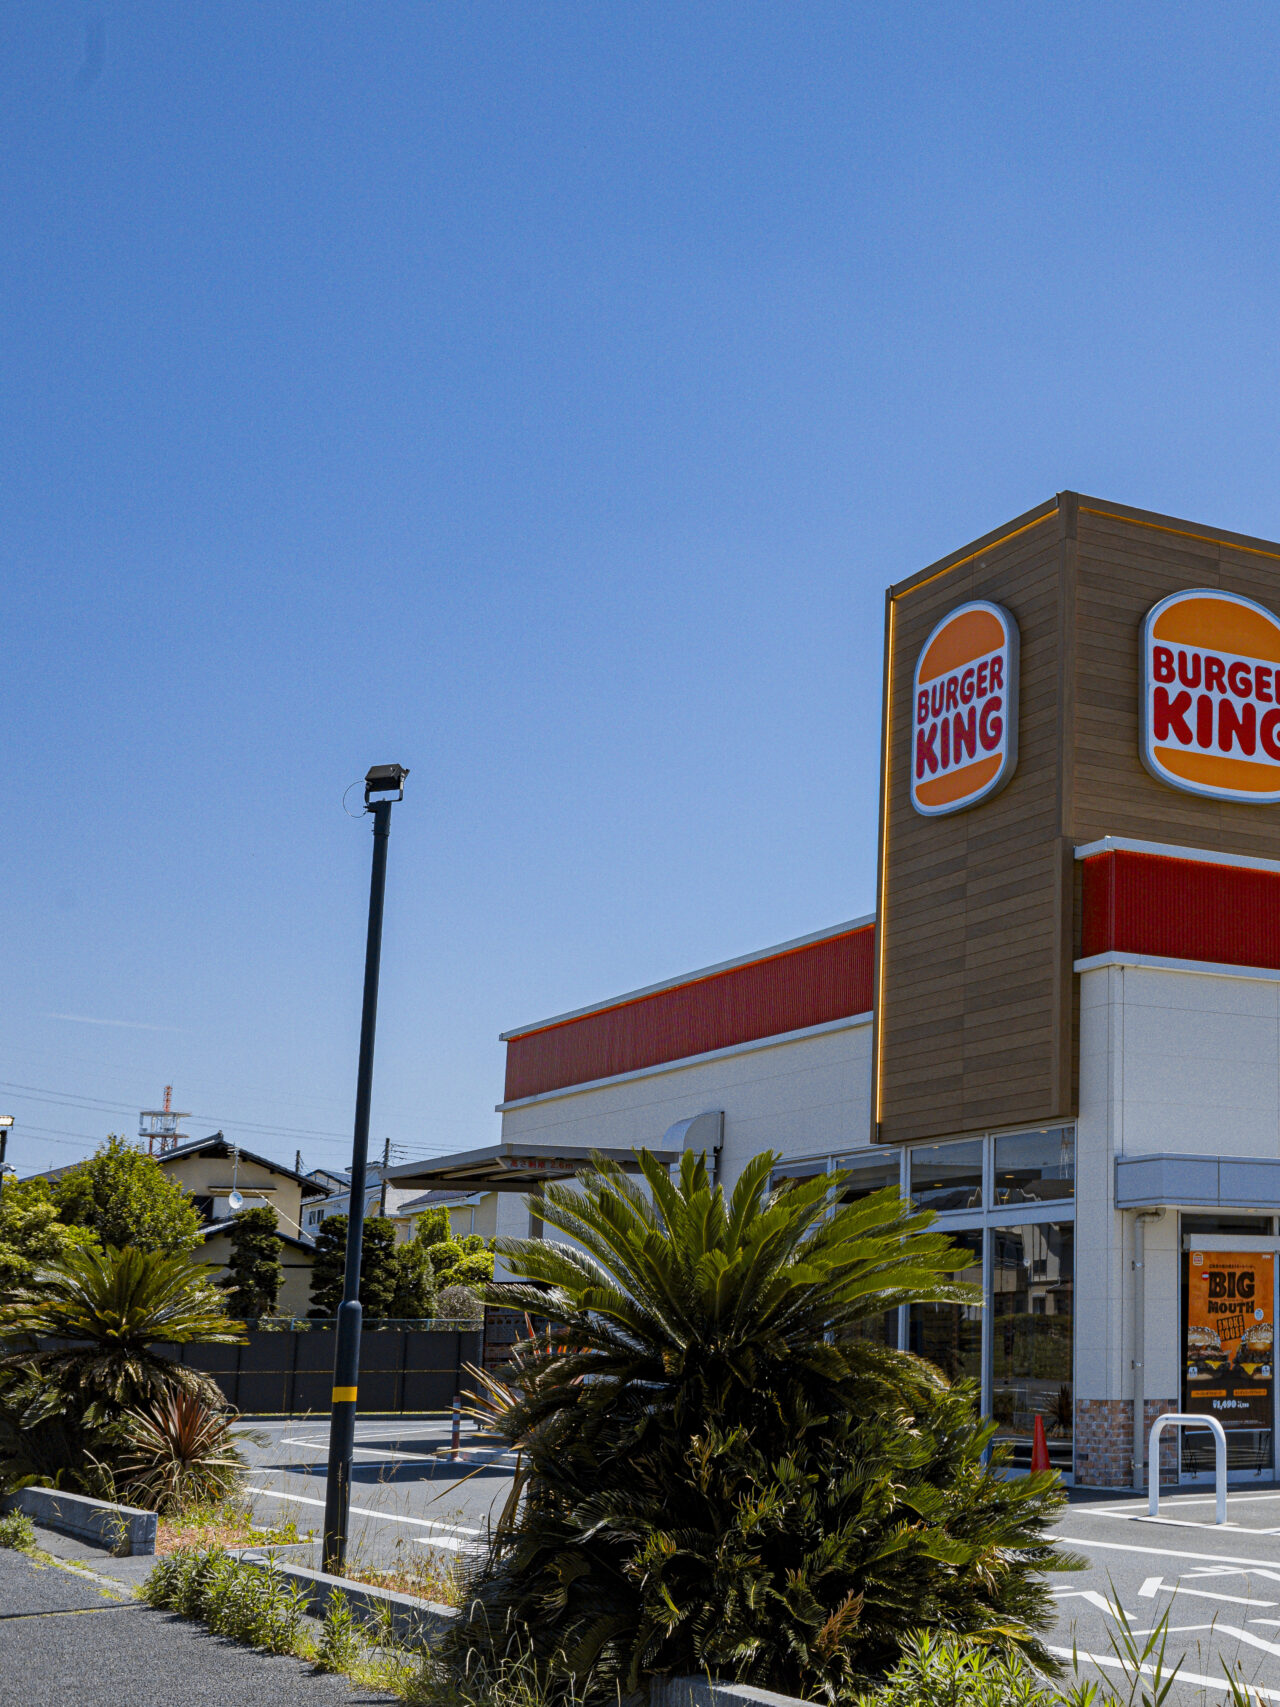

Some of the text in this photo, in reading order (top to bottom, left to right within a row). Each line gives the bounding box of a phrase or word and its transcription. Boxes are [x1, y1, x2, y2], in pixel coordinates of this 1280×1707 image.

[917, 655, 1004, 725] BURGER
[915, 696, 1003, 780] KING
[1208, 1271, 1255, 1299] BIG
[1208, 1300, 1255, 1314] MOUTH
